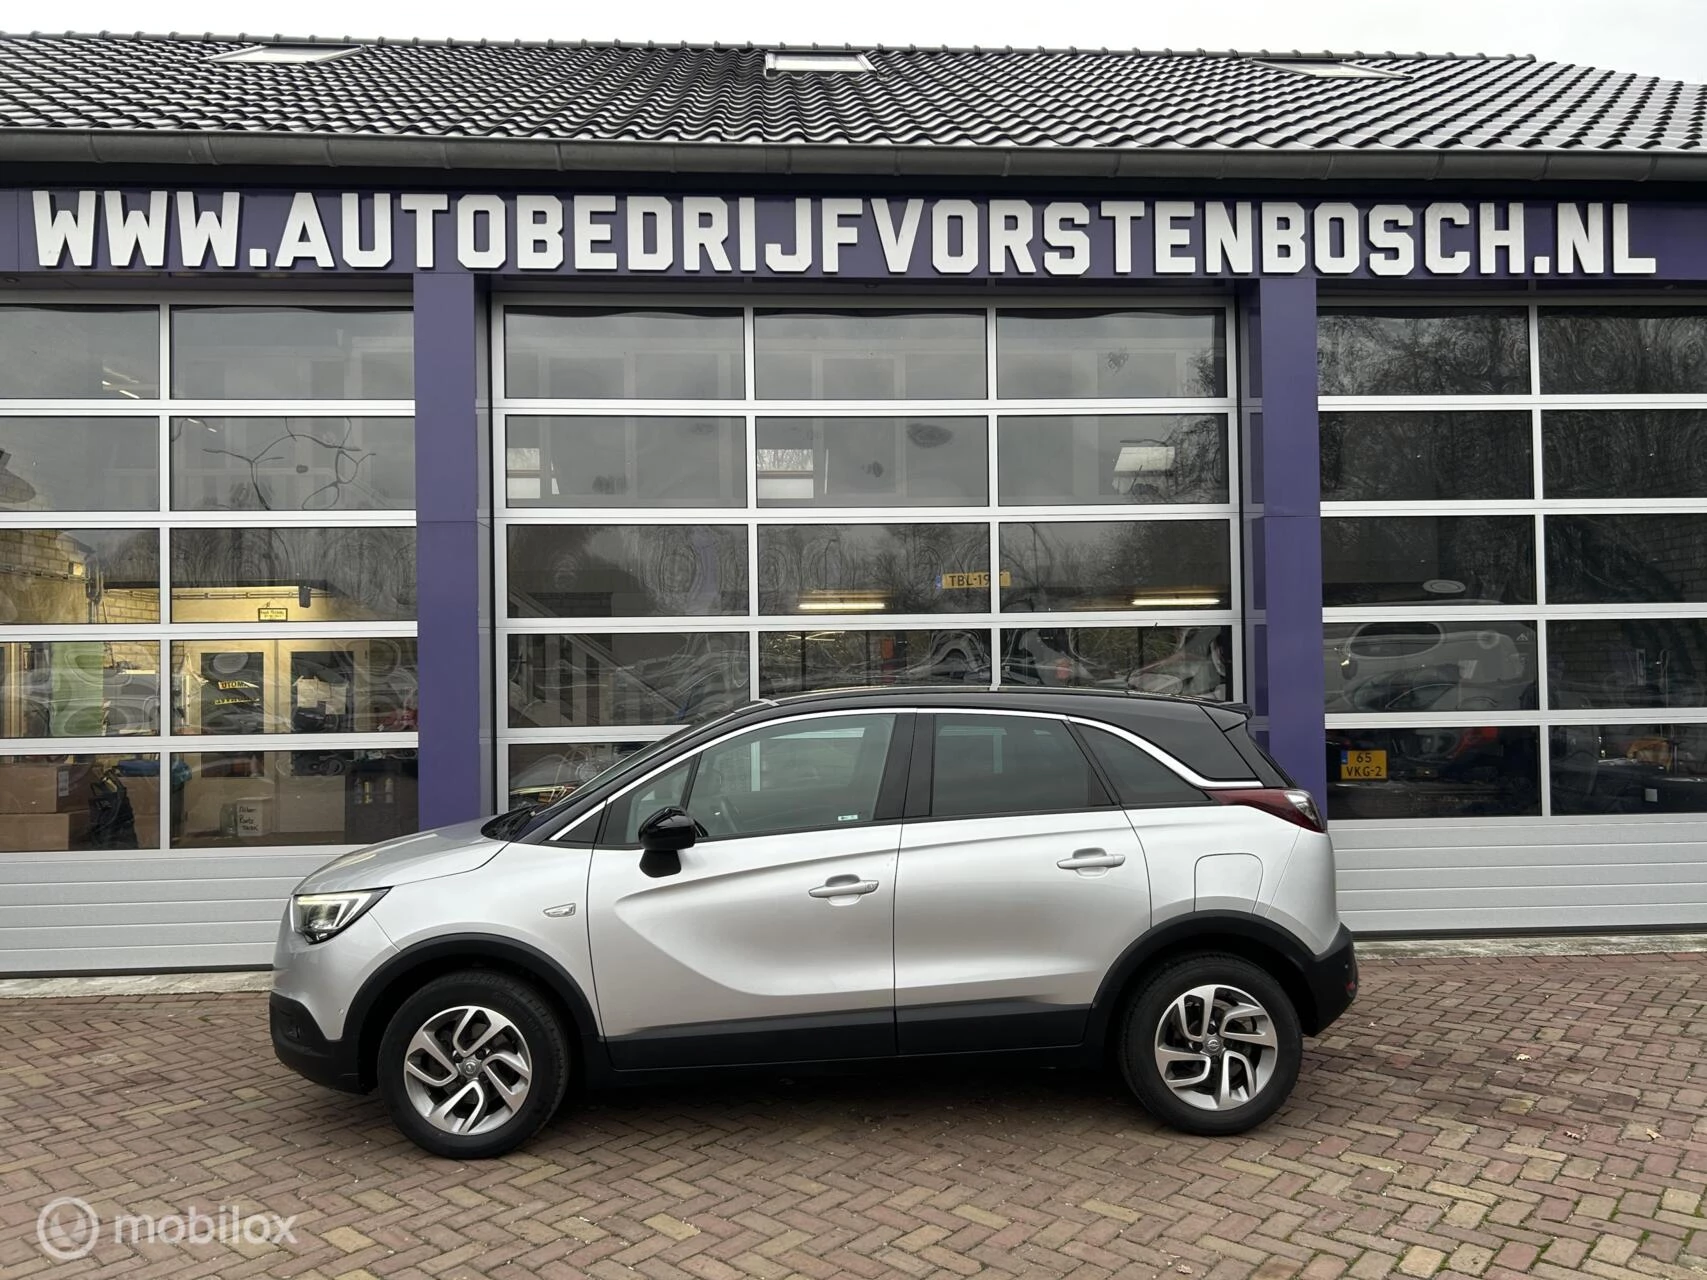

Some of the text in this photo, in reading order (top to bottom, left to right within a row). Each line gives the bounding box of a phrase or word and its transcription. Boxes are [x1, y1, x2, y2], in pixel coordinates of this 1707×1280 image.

[32, 190, 1657, 276] WWW.AUTOBEDRIJFVORSTENBOSCH.NL
[948, 574, 1003, 586] TBL-19
[1356, 753, 1372, 763] 65
[1346, 766, 1382, 777] VKG-2
